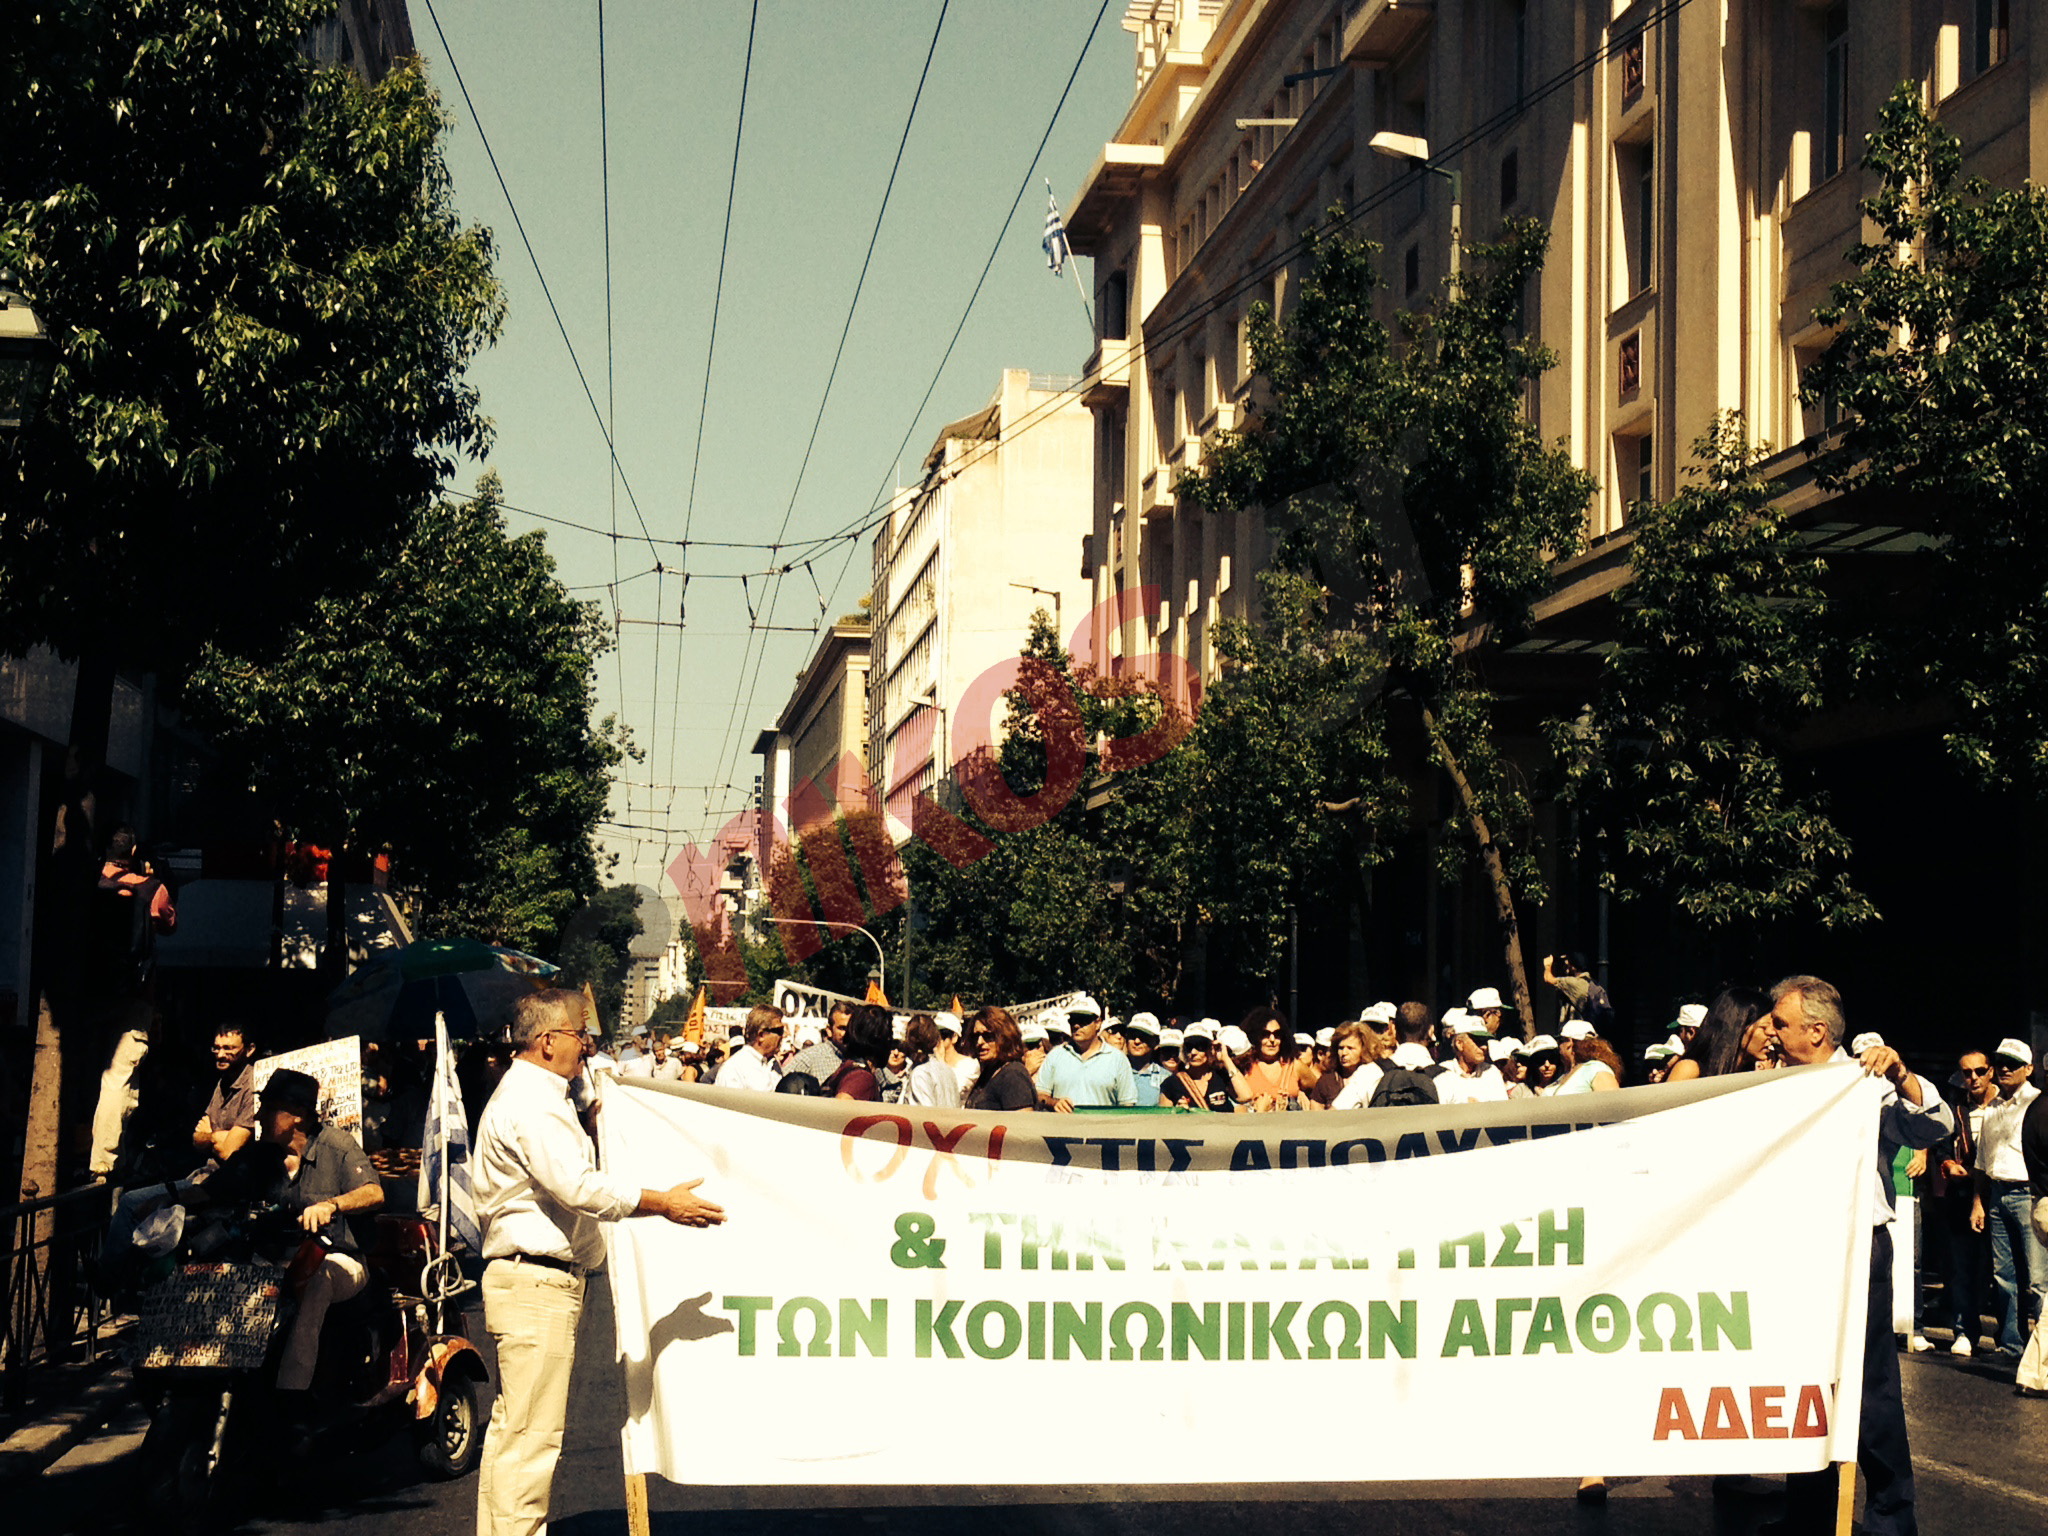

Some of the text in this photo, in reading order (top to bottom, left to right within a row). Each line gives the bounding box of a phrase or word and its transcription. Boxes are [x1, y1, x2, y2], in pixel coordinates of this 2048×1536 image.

[780, 988, 828, 1018] ΟΧΙ
[841, 1114, 1008, 1199] ΟΧΙ
[1043, 1136, 1204, 1186] ΣΤΙΣ
[891, 1211, 947, 1269] &
[722, 1290, 1752, 1361] ΤΩΝ ΚΟΙΝΩΝΙΚΩΝ ΑΓΑΘΩΝ
